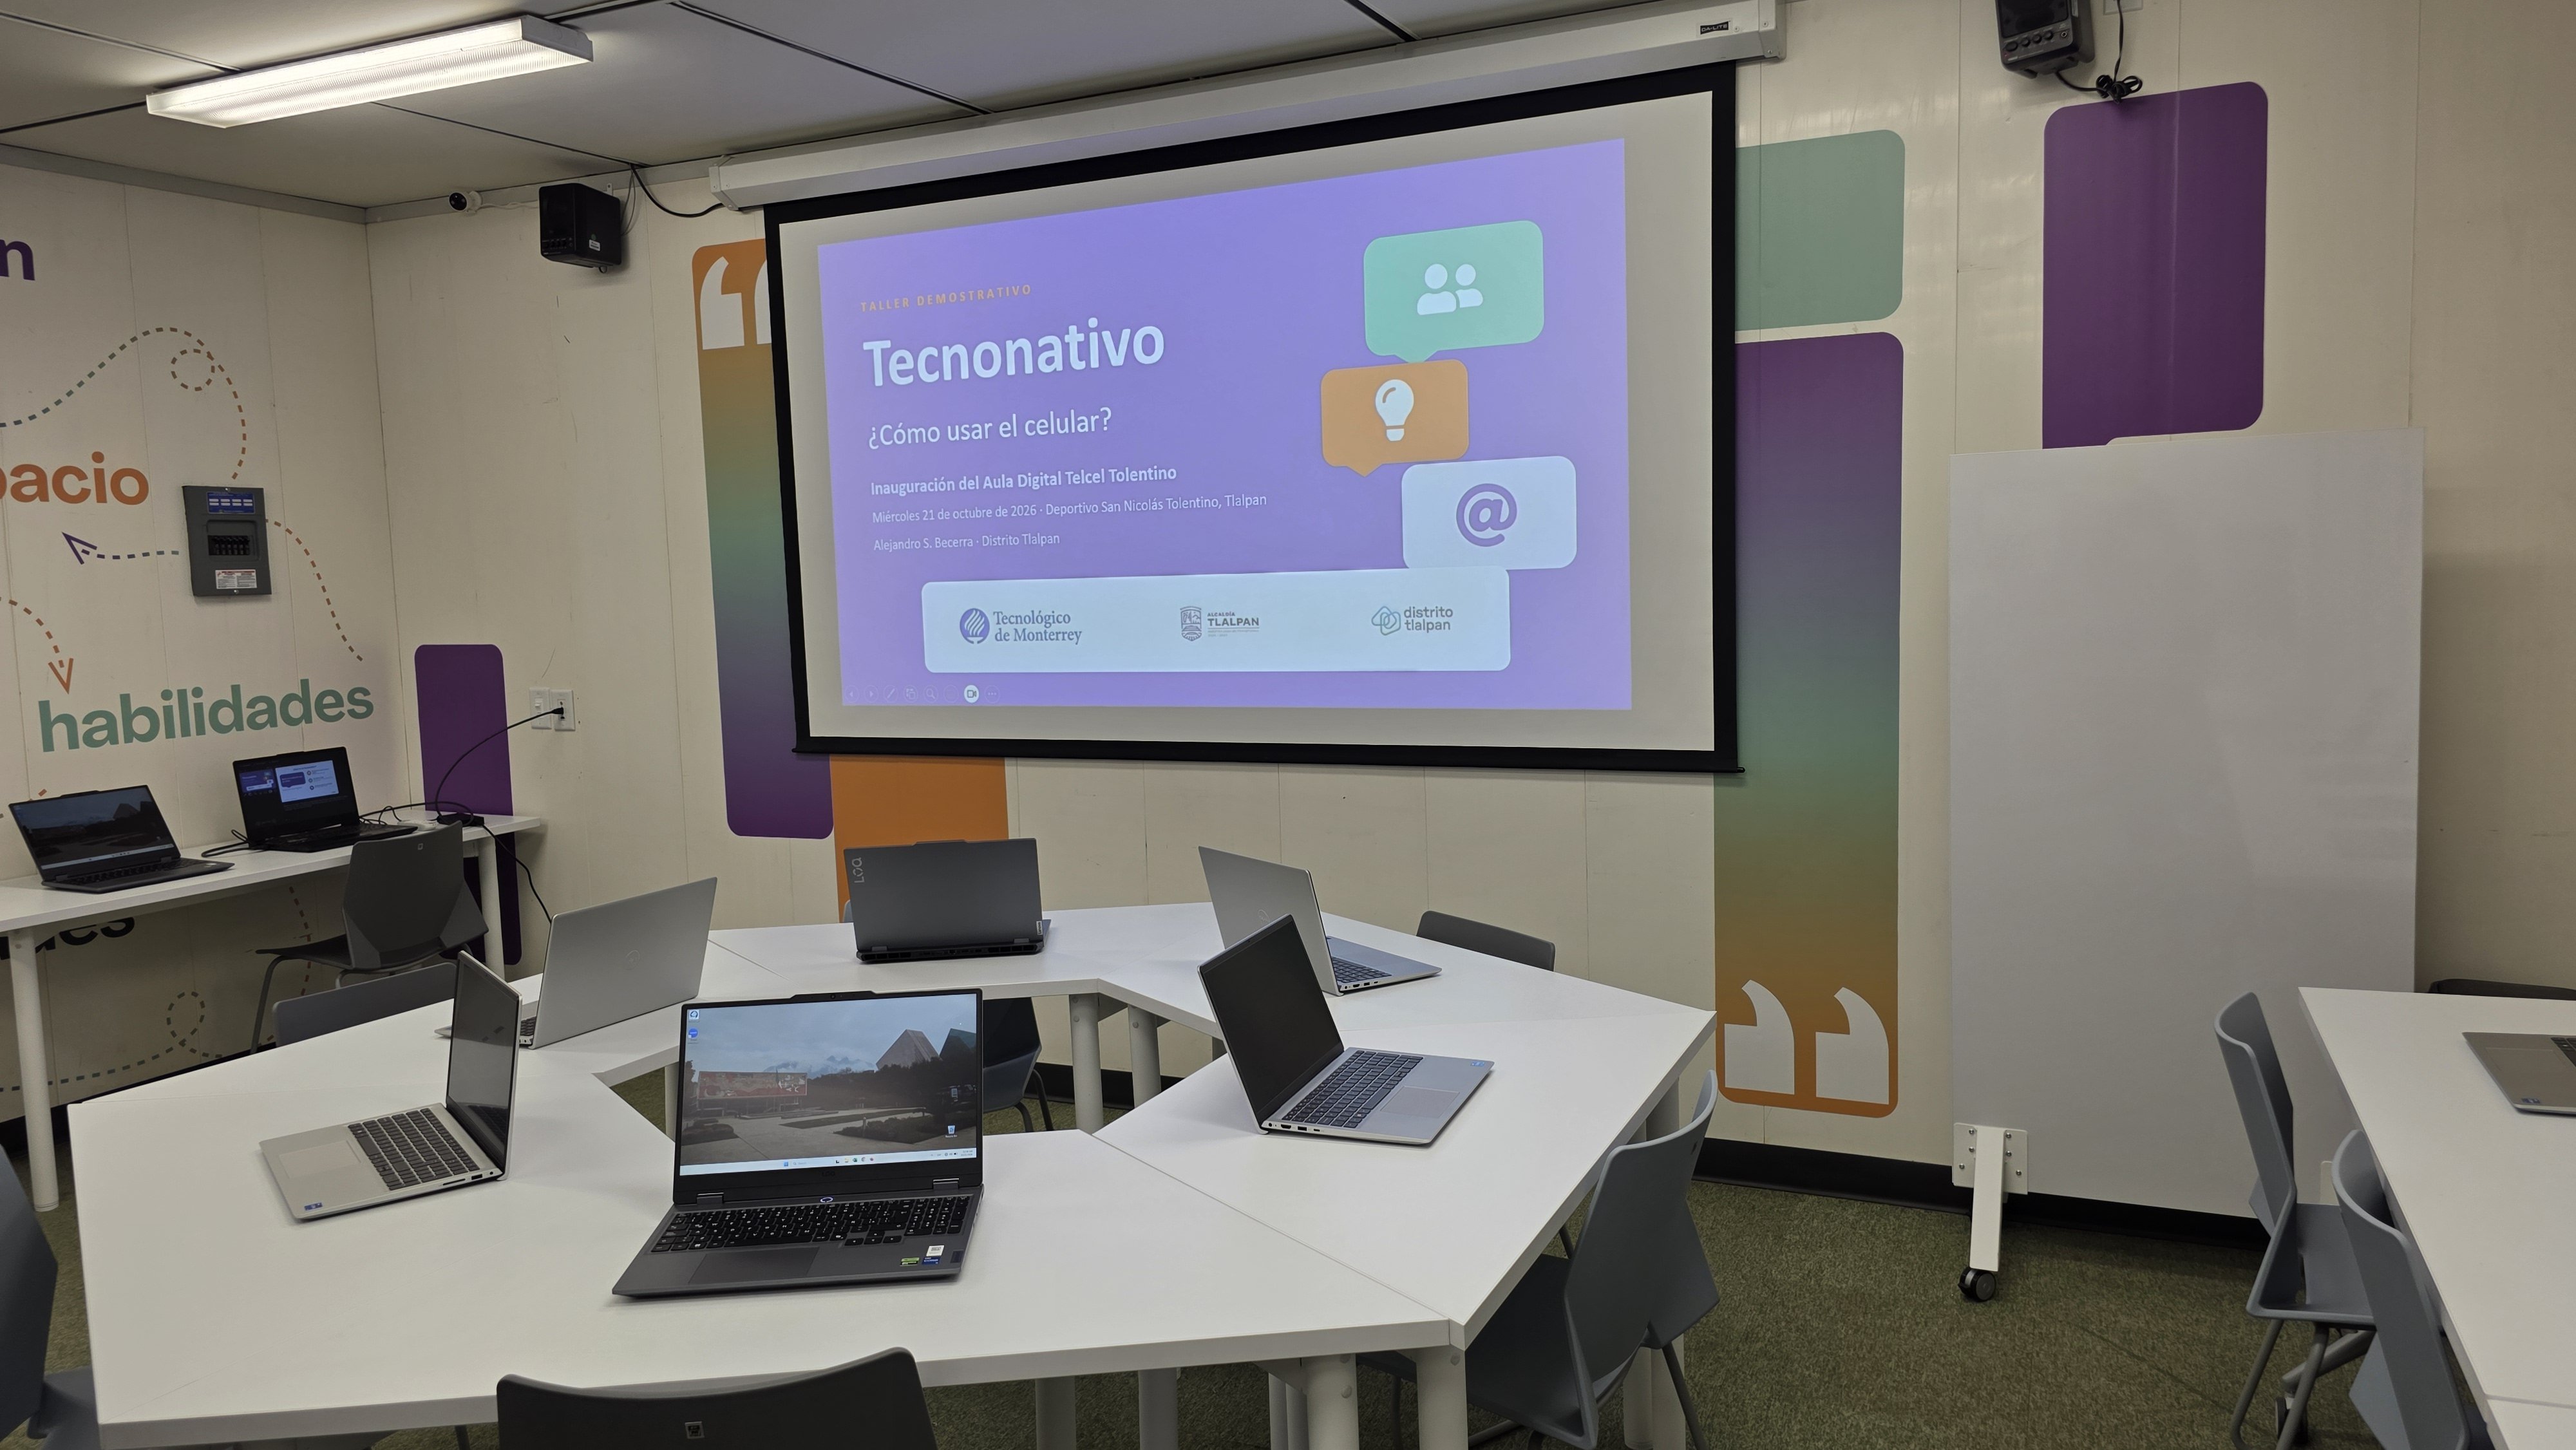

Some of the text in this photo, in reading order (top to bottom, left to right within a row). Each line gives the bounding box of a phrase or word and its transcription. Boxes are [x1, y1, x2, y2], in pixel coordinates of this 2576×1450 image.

[861, 285, 1030, 312] TALLER DEMOSTRATIVO
[863, 317, 1165, 386] Tecnonativo
[869, 407, 1112, 449] ¿Cómo usar el celular?
[0, 451, 149, 505] acio
[871, 466, 1177, 496] Inauguración del Aula Digital Telcel Tolentino
[873, 510, 920, 523] Miércoles
[922, 509, 935, 521] 21
[938, 508, 950, 520] de
[952, 507, 992, 519] octubre
[995, 505, 1009, 517] de
[1010, 505, 1037, 516] 2026
[1046, 502, 1099, 517] Deportivo
[1101, 502, 1121, 513] San
[1124, 498, 1164, 512] Nicolás
[1166, 496, 1222, 510] Tolentino,
[1224, 494, 1267, 509] Tlalpan
[874, 538, 921, 552] Alejandro
[923, 538, 933, 549] S.
[935, 537, 973, 548] Becerra
[982, 534, 1019, 547] Distrito
[1022, 533, 1060, 546] Tlalpan
[993, 610, 1072, 628] Tecnológico
[1208, 617, 1260, 626] TLALPAN
[1403, 606, 1454, 619] distrito
[995, 628, 1082, 645] de Monterrey
[1404, 618, 1451, 634] tlalpan
[39, 679, 375, 752] habilidades
[851, 857, 865, 883] LOQ
